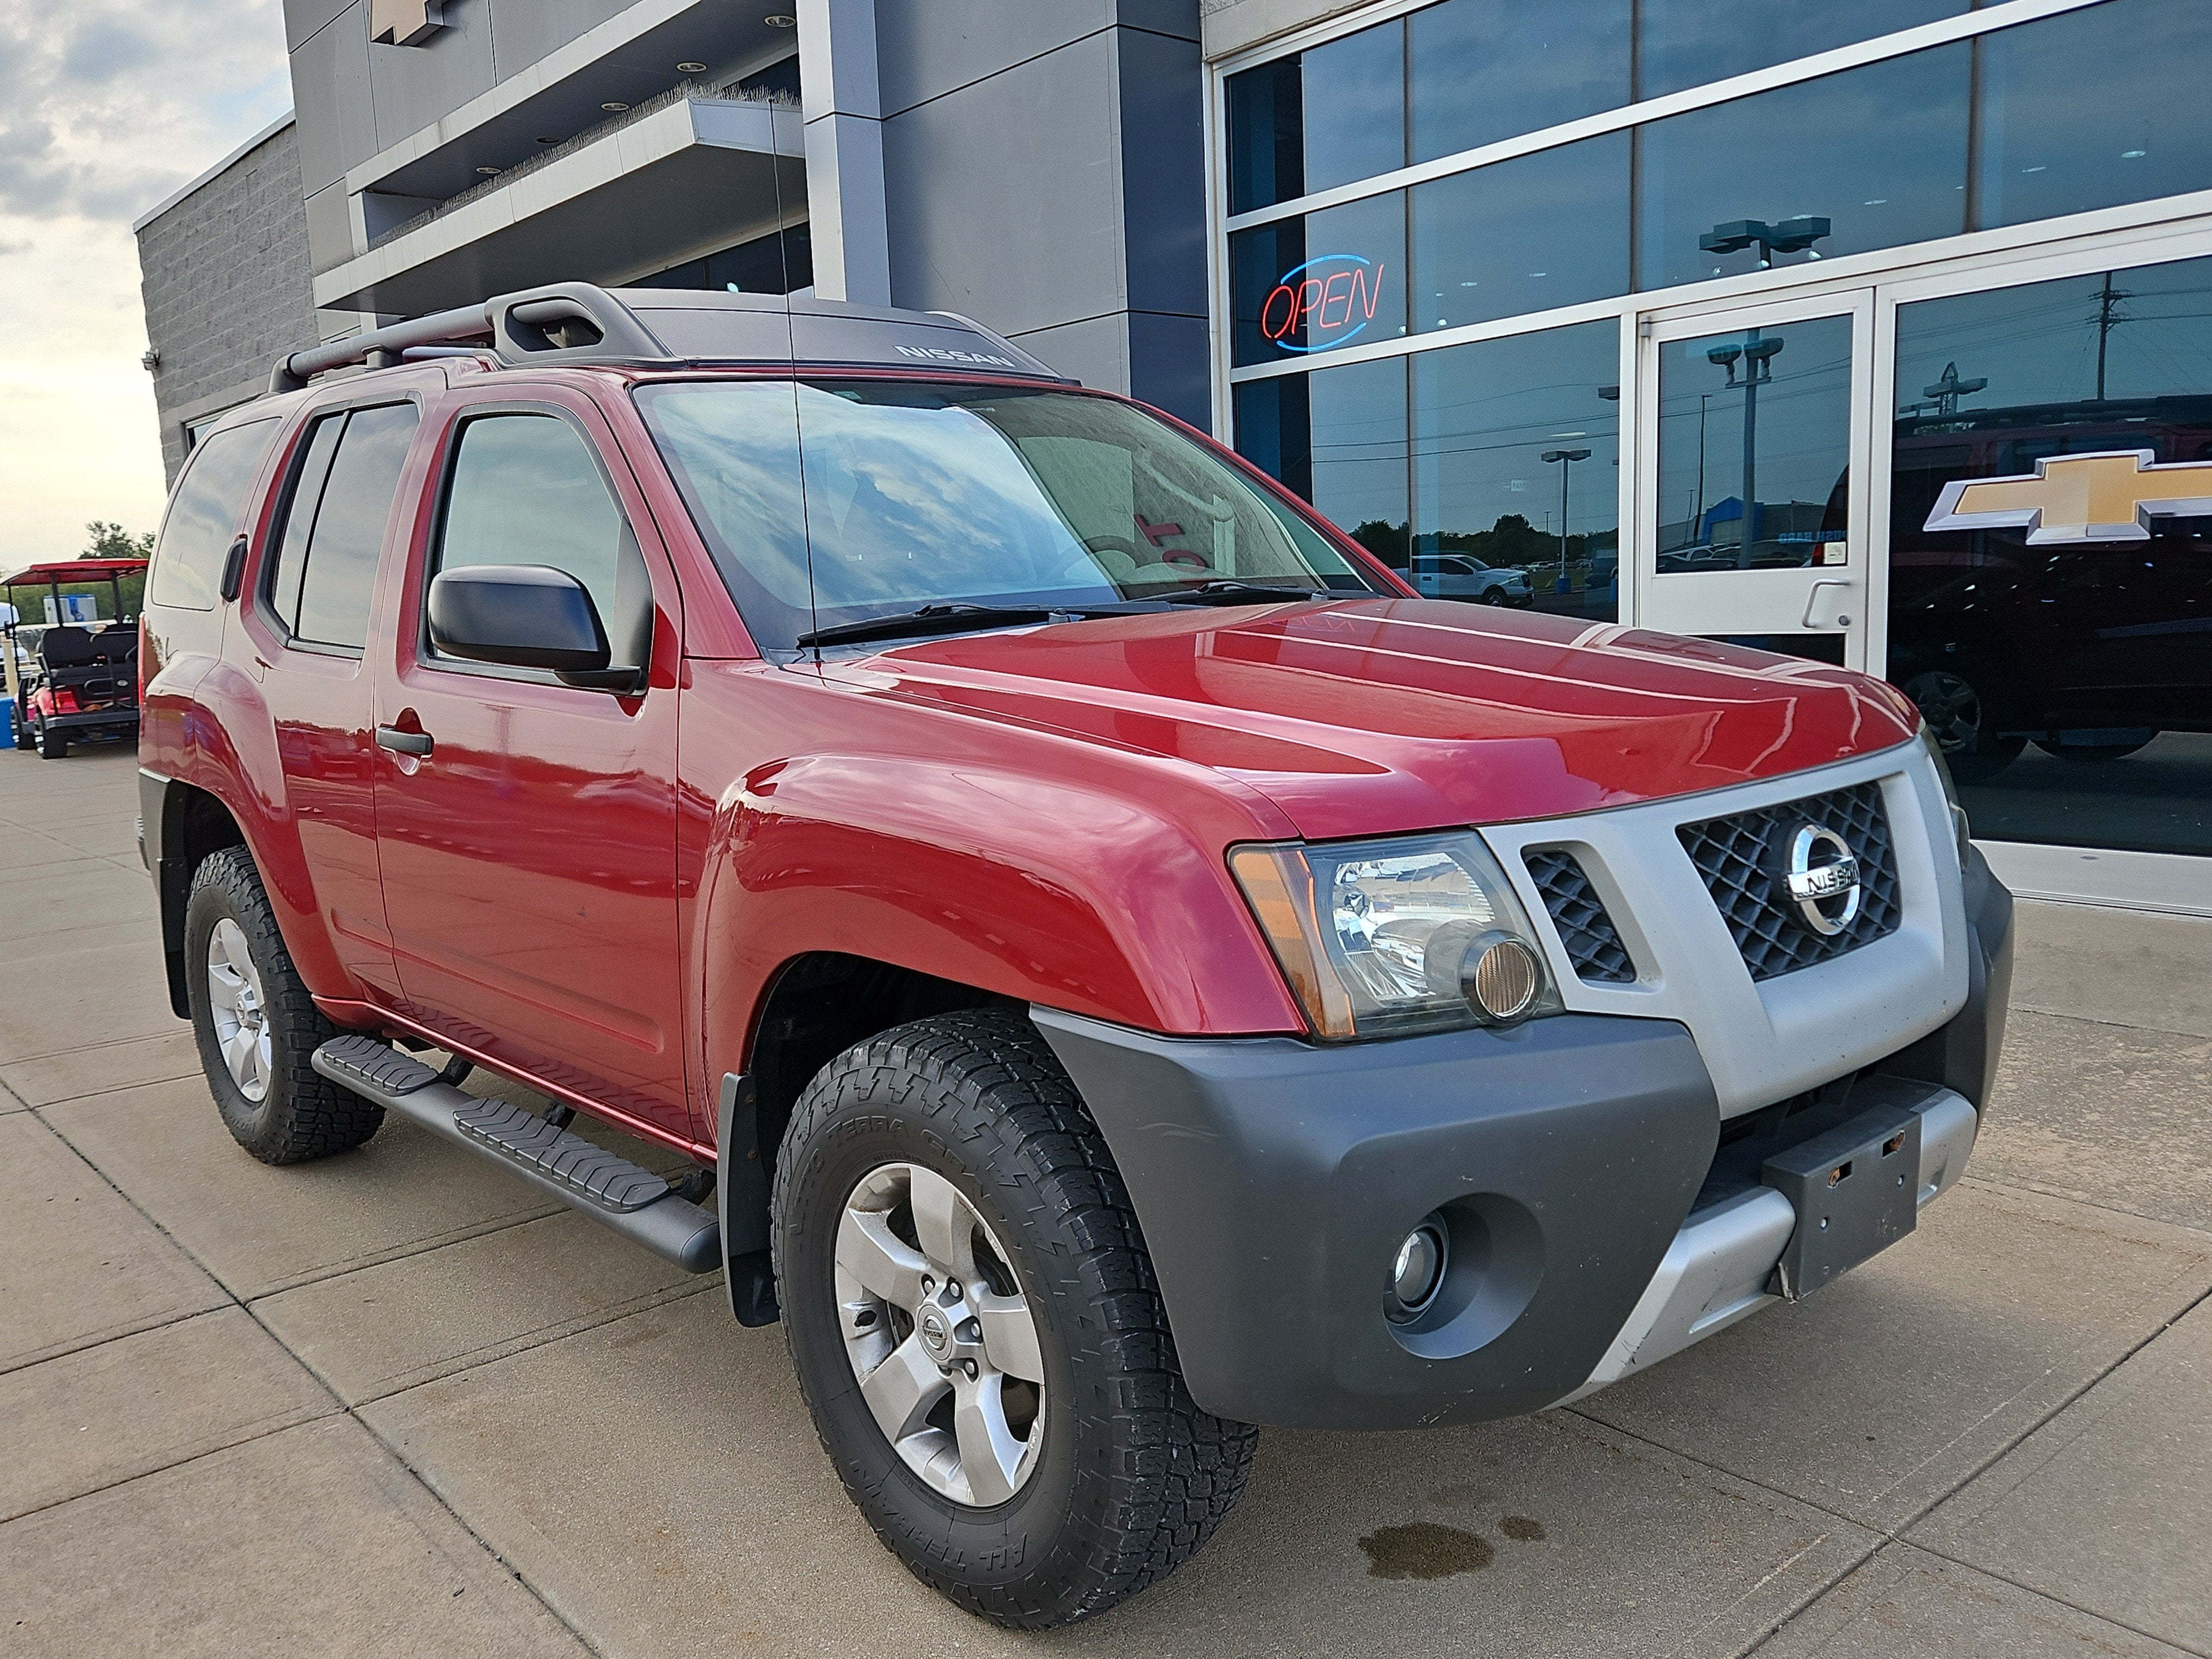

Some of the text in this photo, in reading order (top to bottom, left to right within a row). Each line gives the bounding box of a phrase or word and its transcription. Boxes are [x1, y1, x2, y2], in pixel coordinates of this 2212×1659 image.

[1262, 264, 1385, 339] OPEN
[893, 345, 1016, 368] NISSAN
[825, 1115, 909, 1148] TERRA
[848, 1458, 966, 1573] TERRAIN
[979, 1531, 1029, 1569] ALL
